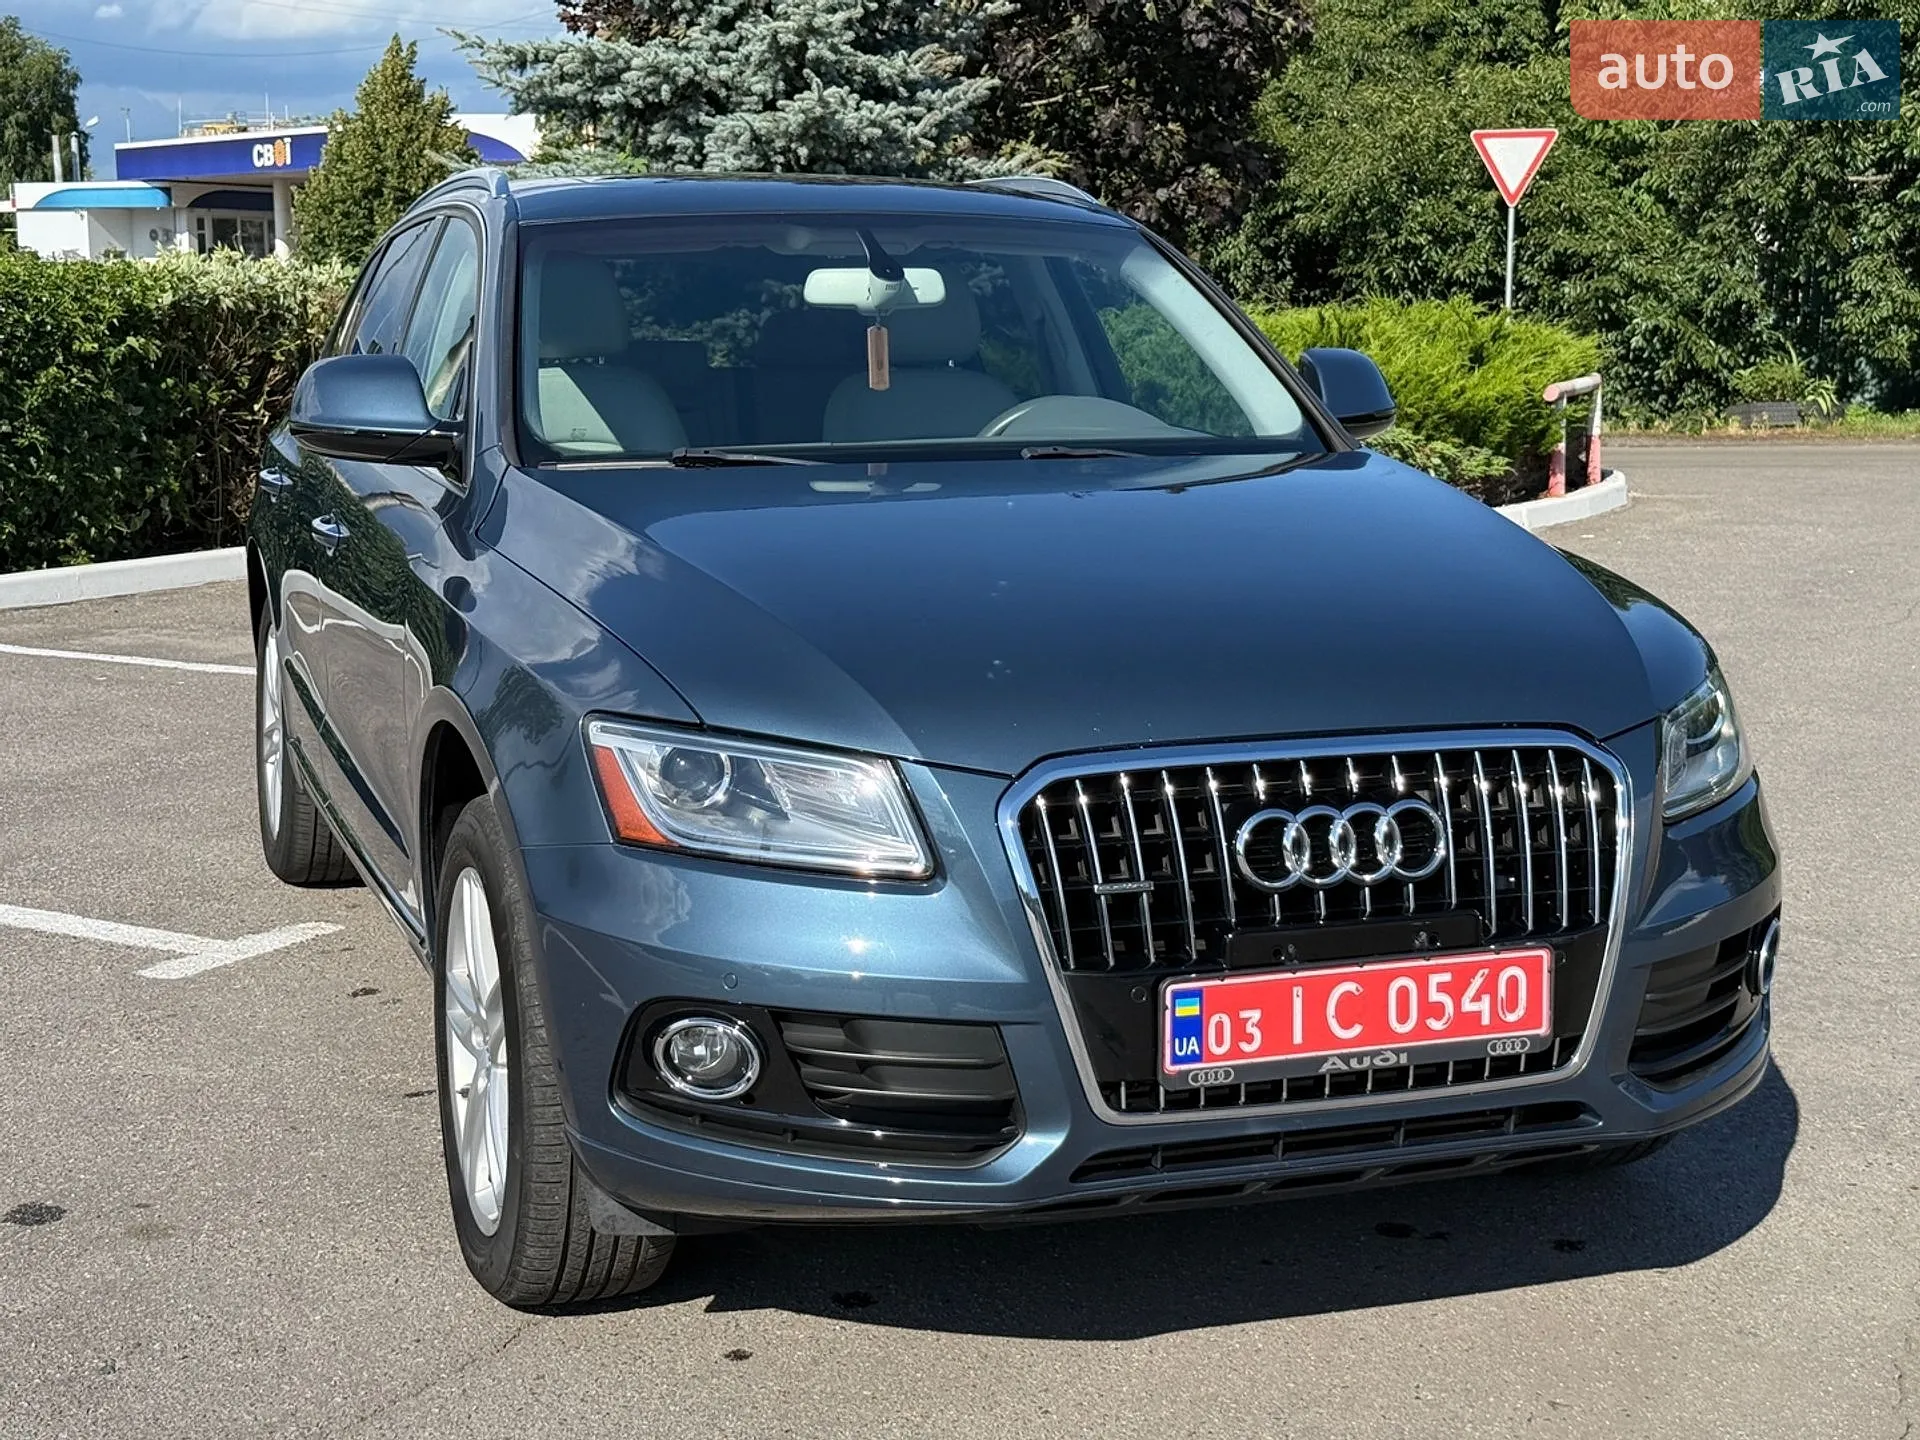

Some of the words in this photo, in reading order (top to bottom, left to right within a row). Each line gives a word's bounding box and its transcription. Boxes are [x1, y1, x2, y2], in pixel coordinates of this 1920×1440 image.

[1207, 1008, 1263, 1055] 03
[1387, 965, 1528, 1034] 0540
[1175, 1037, 1200, 1057] UA
[1317, 1050, 1408, 1073] Audi
